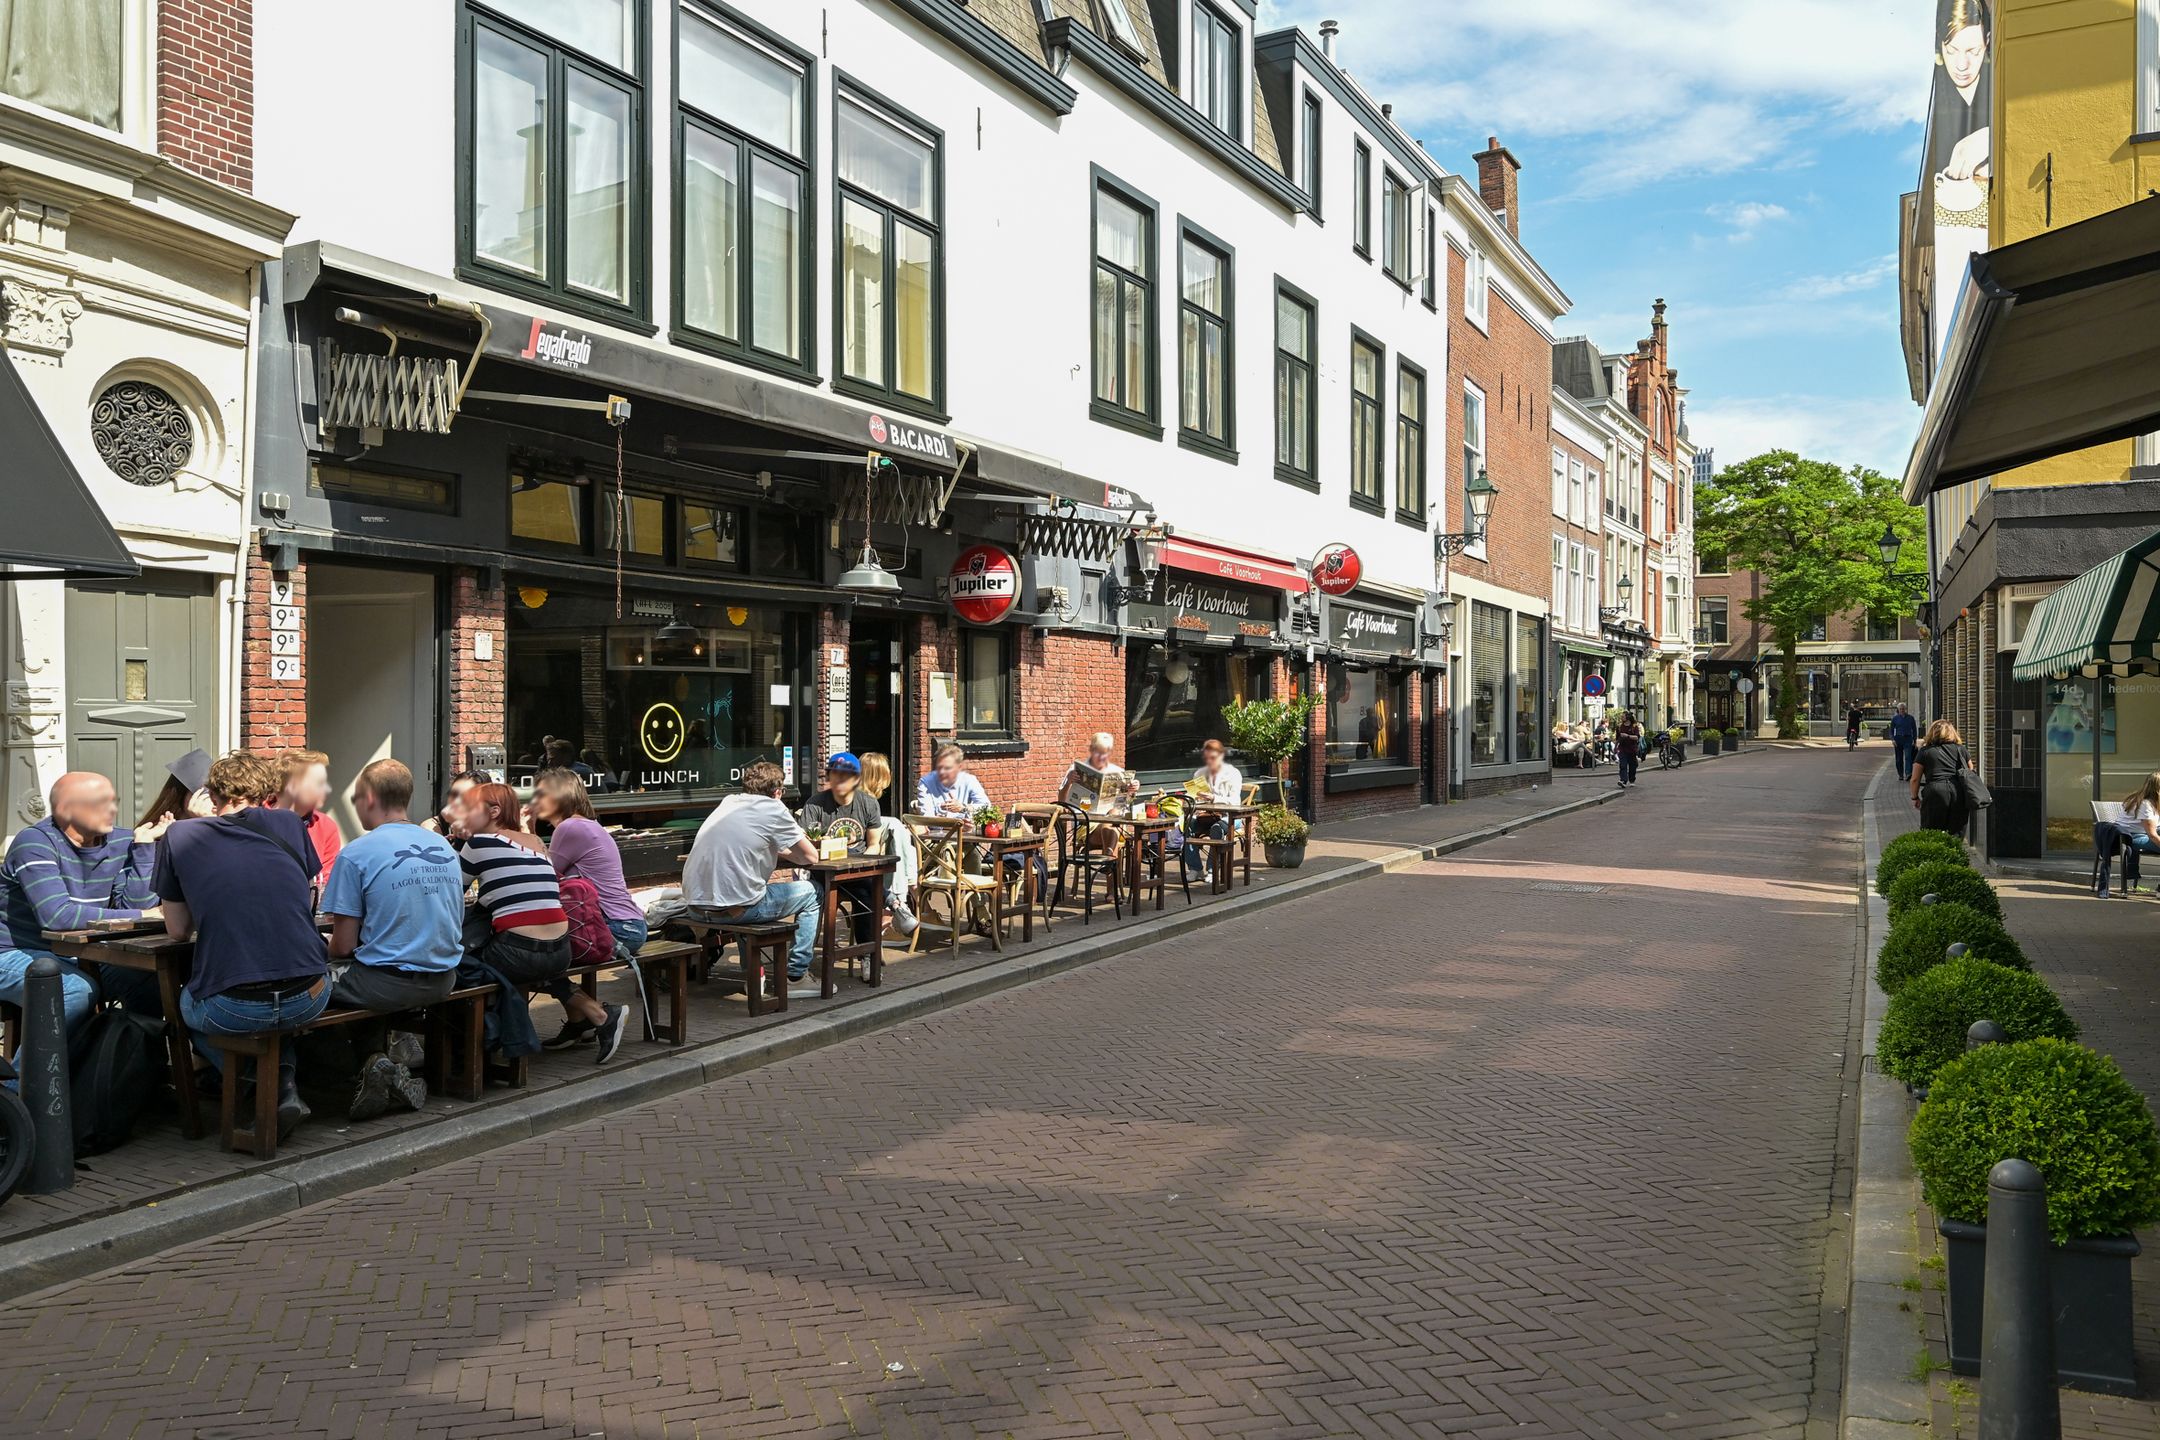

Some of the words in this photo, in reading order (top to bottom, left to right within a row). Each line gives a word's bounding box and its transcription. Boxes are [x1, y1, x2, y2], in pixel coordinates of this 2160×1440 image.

[522, 317, 592, 364] Segafredo
[552, 357, 579, 369] ZANETTI
[1219, 562, 1233, 575] Café
[954, 575, 1008, 595] Jupiler
[1320, 577, 1351, 587] Jupiler
[277, 584, 288, 602] 9
[1164, 582, 1194, 618] Café
[1196, 588, 1249, 616] Voorhout
[1347, 611, 1365, 638] Café
[1365, 614, 1398, 635] Voorhout
[1830, 655, 1853, 663] CAMP
[2054, 684, 2077, 694] 14d
[641, 770, 700, 785] LUNCH
[420, 865, 448, 873] TROFEO
[391, 877, 414, 891] LAGO
[414, 877, 421, 885] di
[424, 886, 439, 895] 2004
